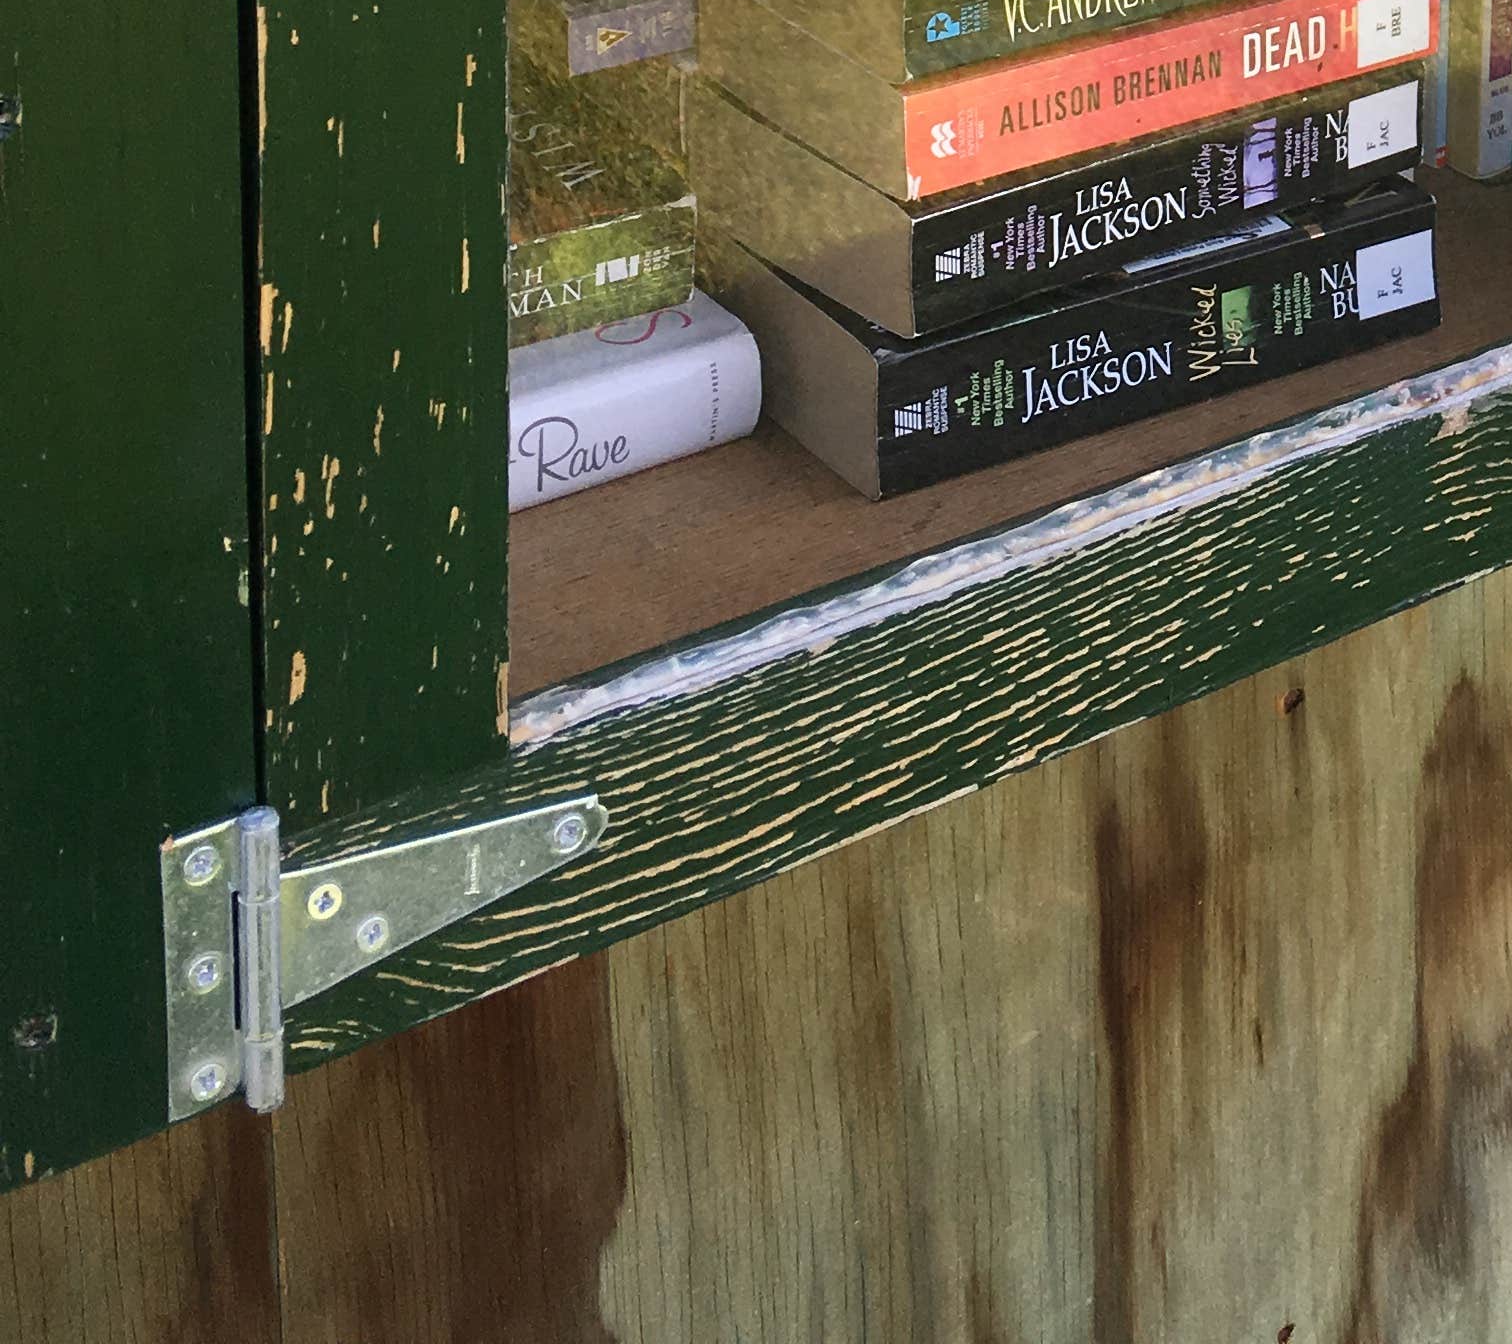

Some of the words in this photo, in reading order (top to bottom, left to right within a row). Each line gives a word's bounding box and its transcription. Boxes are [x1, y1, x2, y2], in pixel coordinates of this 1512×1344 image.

[1391, 6, 1401, 37] BRE
[1243, 15, 1326, 79] DEAD
[999, 83, 1102, 137] ALLISON
[1114, 50, 1222, 108] BRENNAN
[1284, 127, 1293, 154] York
[1293, 133, 1301, 167] Times
[1301, 116, 1312, 178] Bestselling
[1311, 126, 1320, 162] Author
[1380, 120, 1390, 147] JAC
[1217, 144, 1240, 207] Wicked
[1284, 154, 1293, 177] New
[1075, 176, 1133, 215] LISA
[1005, 217, 1015, 245] York
[1016, 222, 1025, 259] Times
[1026, 204, 1038, 271] Bestselling
[1036, 214, 1045, 253] Author
[1049, 186, 1188, 268] JACKSON
[1005, 247, 1015, 270] New
[1272, 283, 1282, 311] York
[1391, 266, 1403, 295] JAC
[1283, 288, 1292, 323] Times
[1294, 271, 1304, 336] Bestselling
[1187, 283, 1222, 382] Wicked
[1219, 316, 1259, 365] Lies
[1273, 311, 1284, 335] New
[1050, 330, 1112, 370] LISA
[970, 371, 980, 402] York
[981, 377, 992, 414] Times
[993, 359, 1005, 427] Bestselling
[1004, 369, 1014, 409] Author
[1021, 341, 1173, 424] JACKSON
[971, 402, 981, 426] New
[519, 416, 630, 492] Rave
